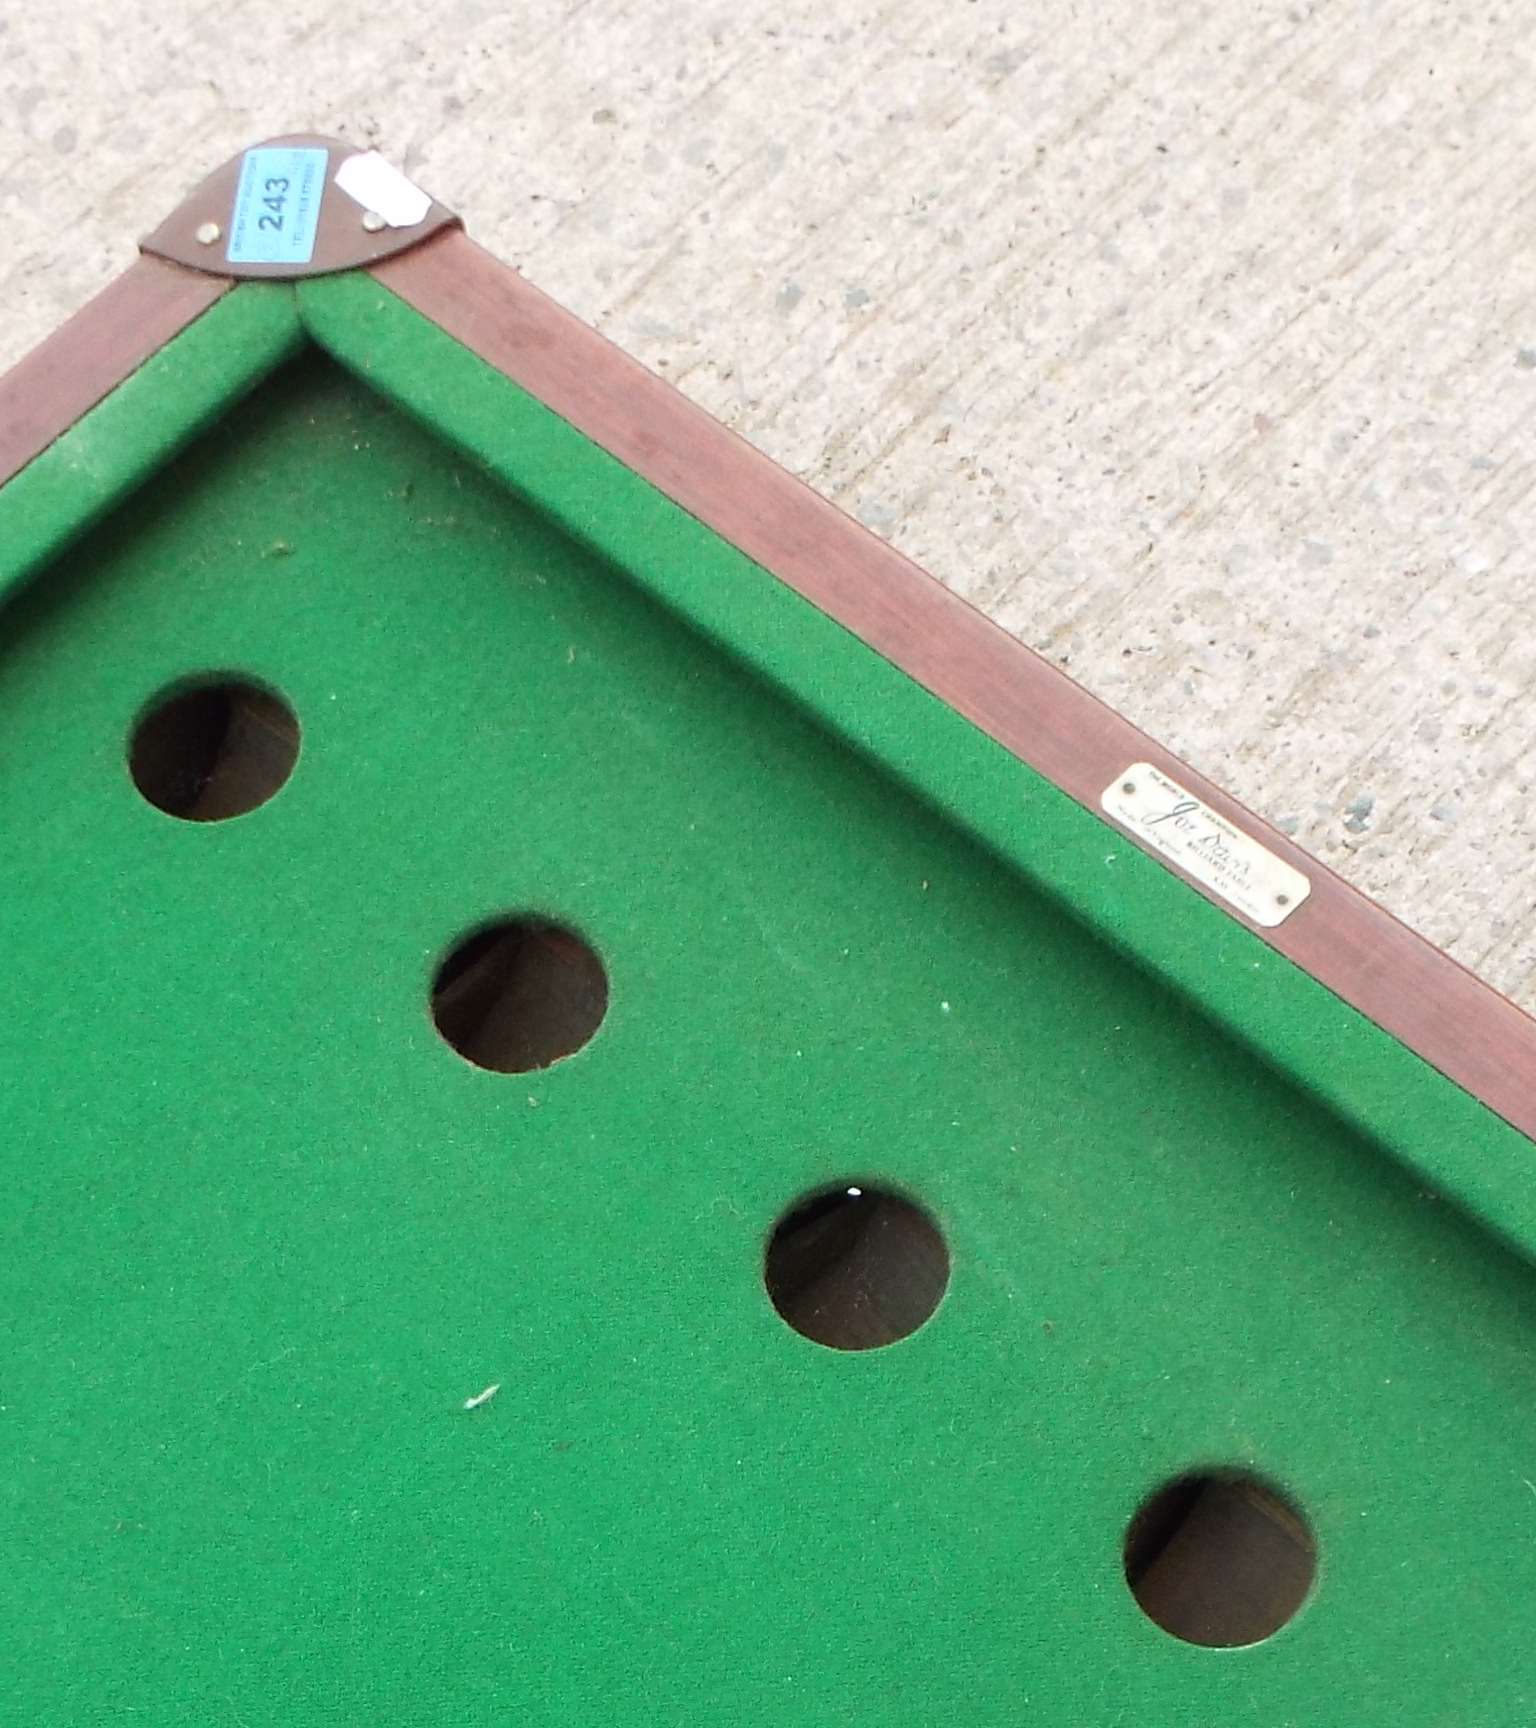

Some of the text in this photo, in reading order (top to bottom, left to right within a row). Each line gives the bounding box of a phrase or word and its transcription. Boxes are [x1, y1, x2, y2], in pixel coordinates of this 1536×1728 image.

[258, 177, 289, 232] 243
[1142, 801, 1197, 832] Joe
[1186, 841, 1227, 873] BILLIARD
